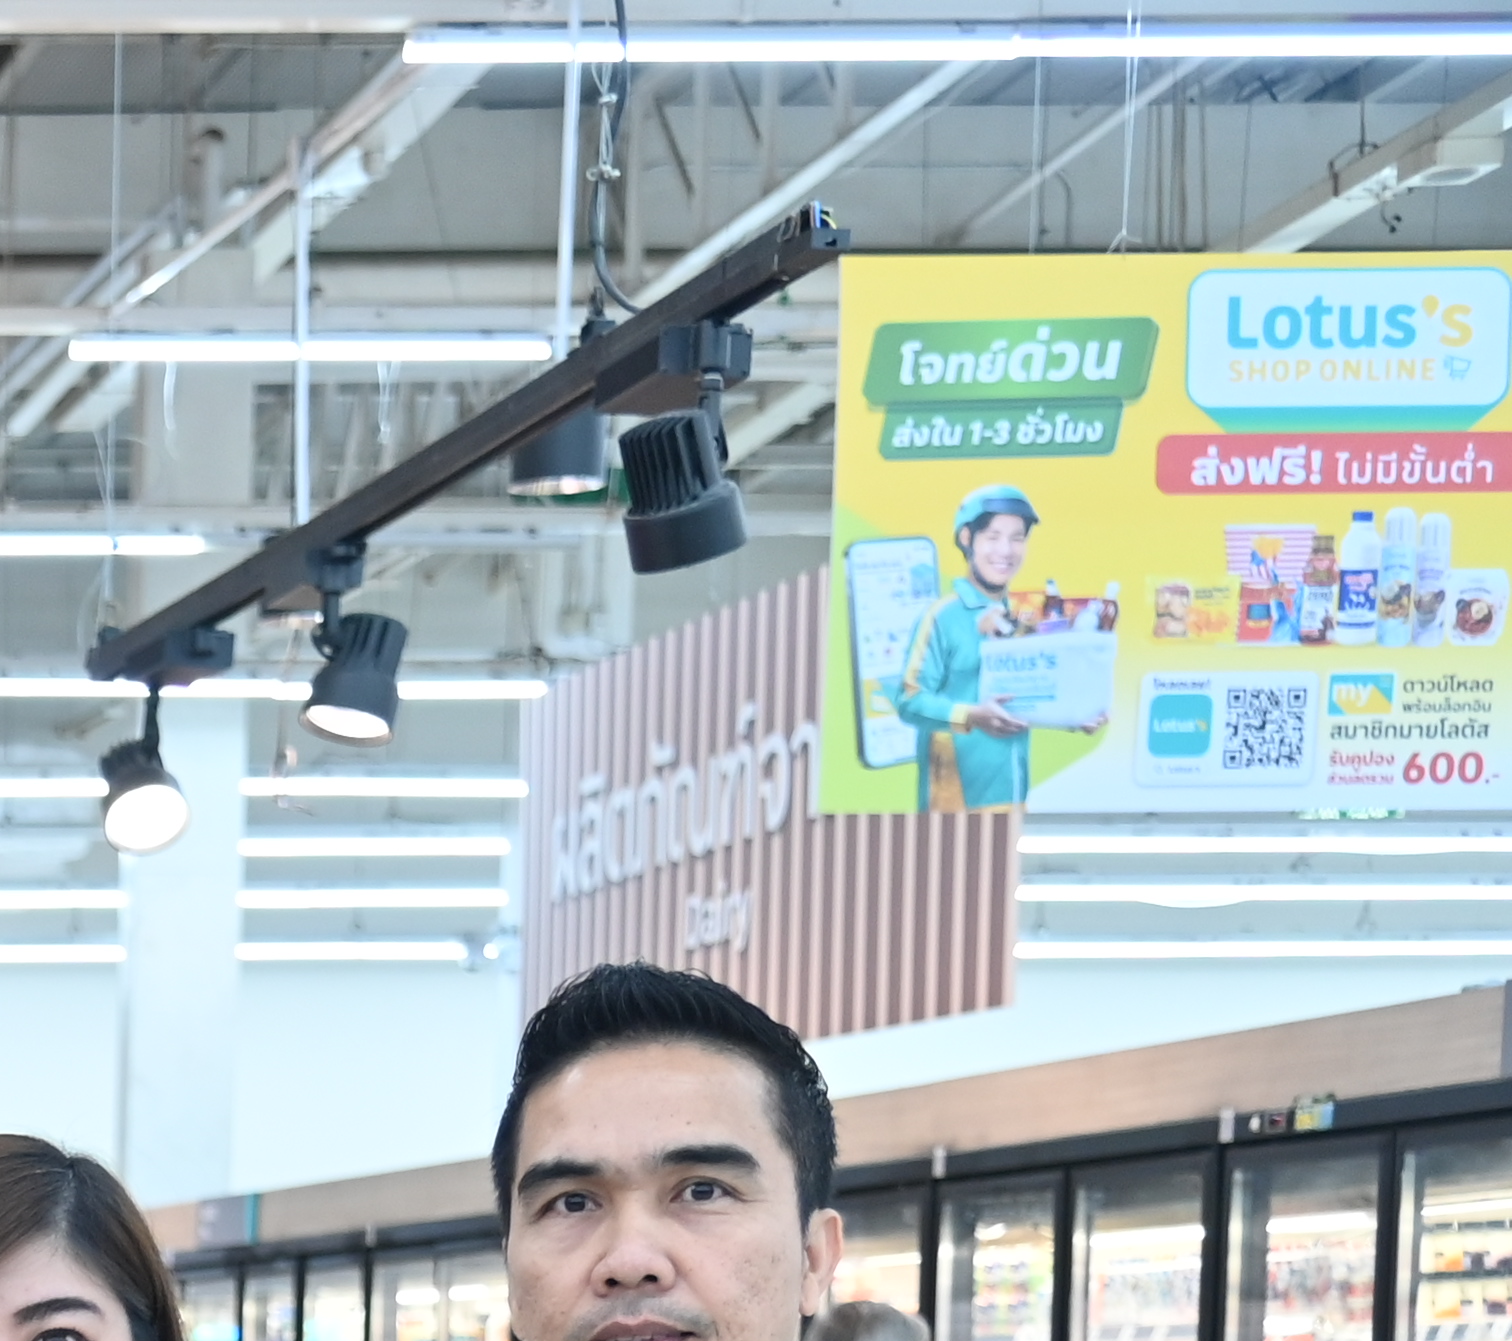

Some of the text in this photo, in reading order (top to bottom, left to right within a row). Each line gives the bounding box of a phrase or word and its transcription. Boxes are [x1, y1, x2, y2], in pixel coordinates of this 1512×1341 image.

[1226, 294, 1474, 350] Lotus's
[898, 324, 1123, 386] โจทย์ด่วน
[1228, 357, 1437, 383] SHOP ONLINE
[891, 405, 1105, 448] ส่งใน 1-3 ชั่วโมง
[1190, 442, 1495, 487] ส่งฟรี! ไม่มีขั้นต่ำ
[1402, 675, 1495, 694] ดาวน์โหลด
[1329, 717, 1491, 741] สมาชิกมายโลตัส
[552, 700, 821, 903] ผลิตภัณฑ์จา
